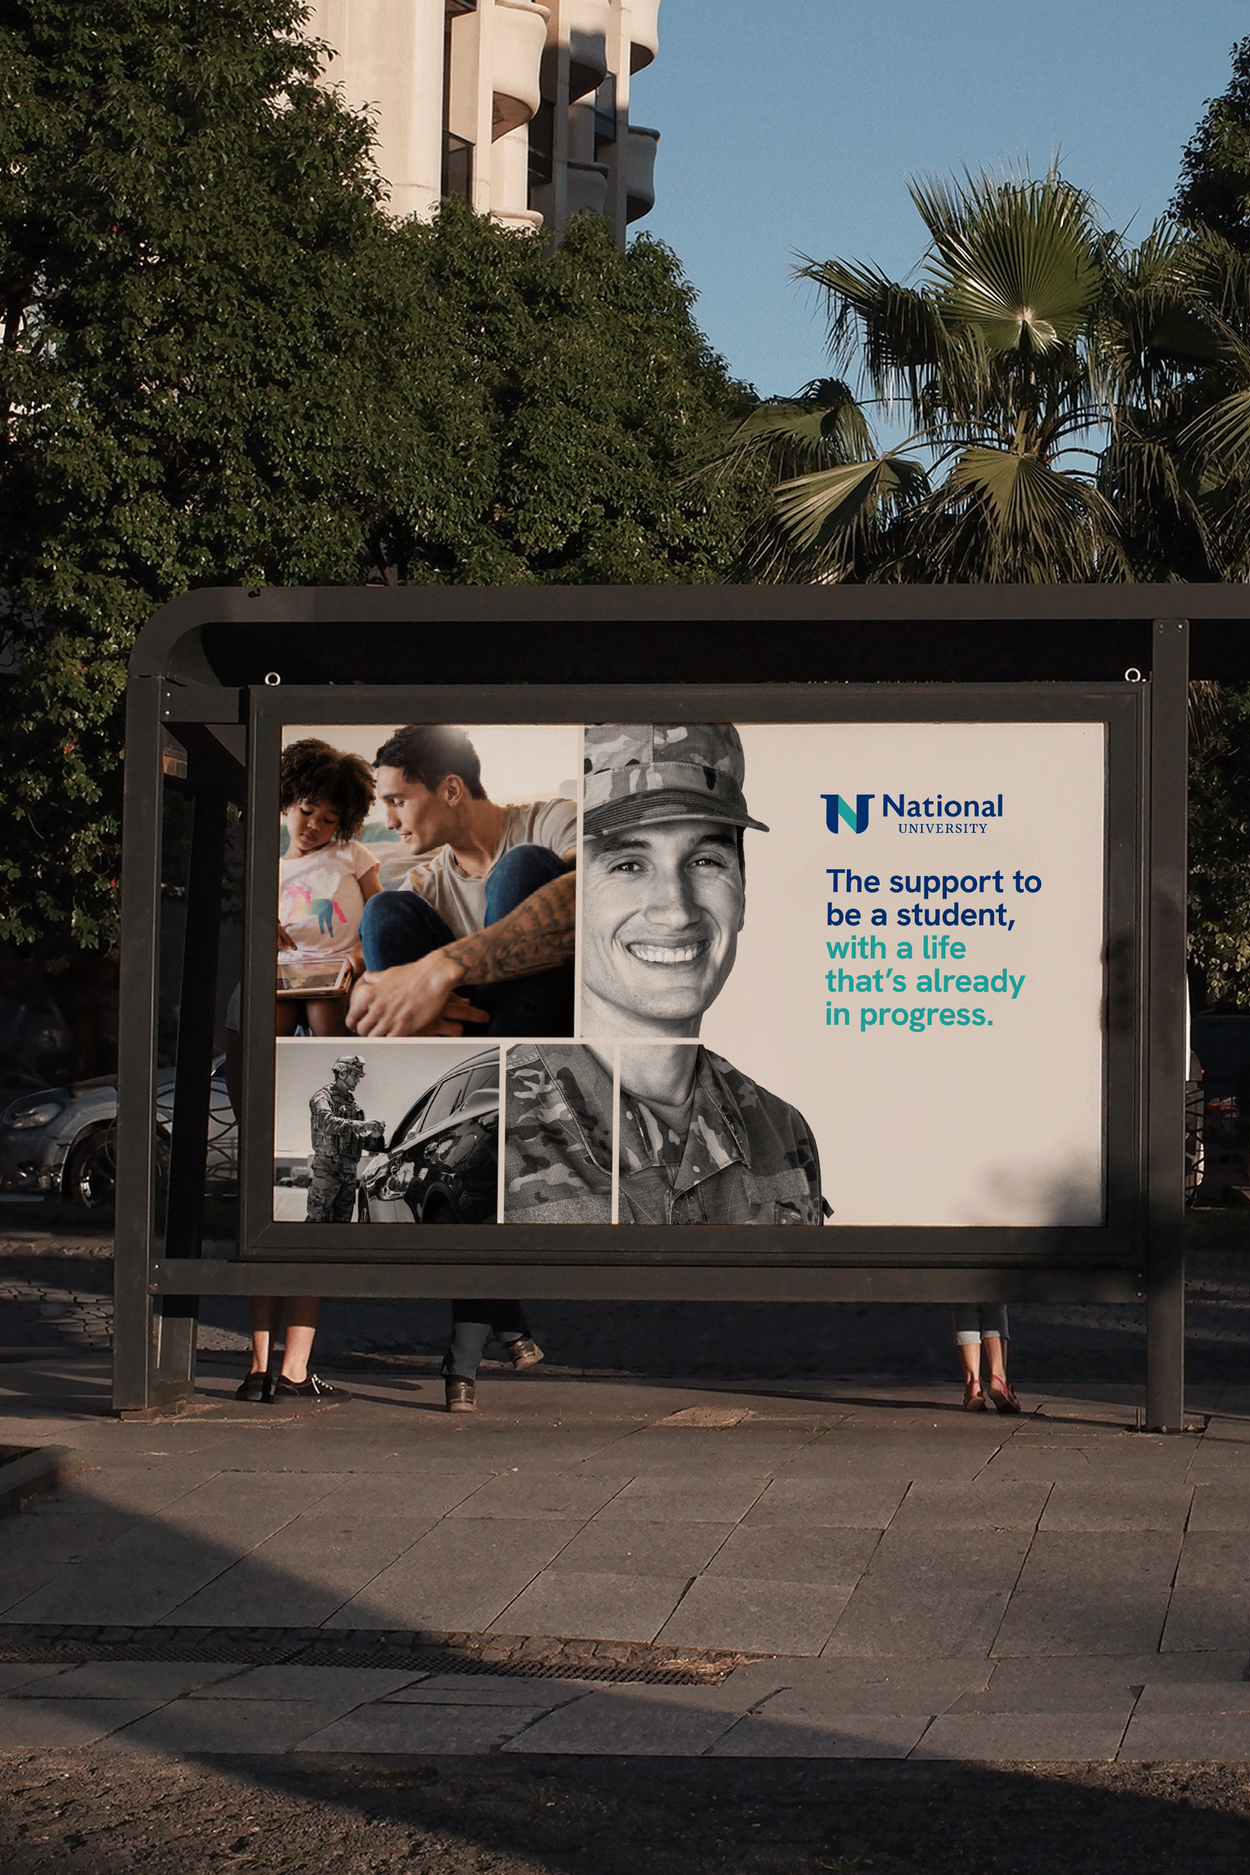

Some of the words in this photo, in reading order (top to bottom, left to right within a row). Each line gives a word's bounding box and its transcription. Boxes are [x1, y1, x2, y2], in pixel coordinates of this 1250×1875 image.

[883, 794, 1002, 817] National
[899, 824, 987, 833] UNIVERSITY
[826, 869, 880, 893] The
[890, 870, 1003, 899] support
[1013, 870, 1041, 893] to
[828, 902, 861, 926] be
[871, 909, 886, 926] a
[897, 902, 1015, 931] student,
[826, 935, 886, 959] with
[897, 942, 912, 959] a
[924, 935, 966, 959] life
[825, 968, 906, 992] that’s
[917, 969, 1025, 999] already
[827, 1002, 849, 1025] in
[861, 1007, 992, 1032] progress.
